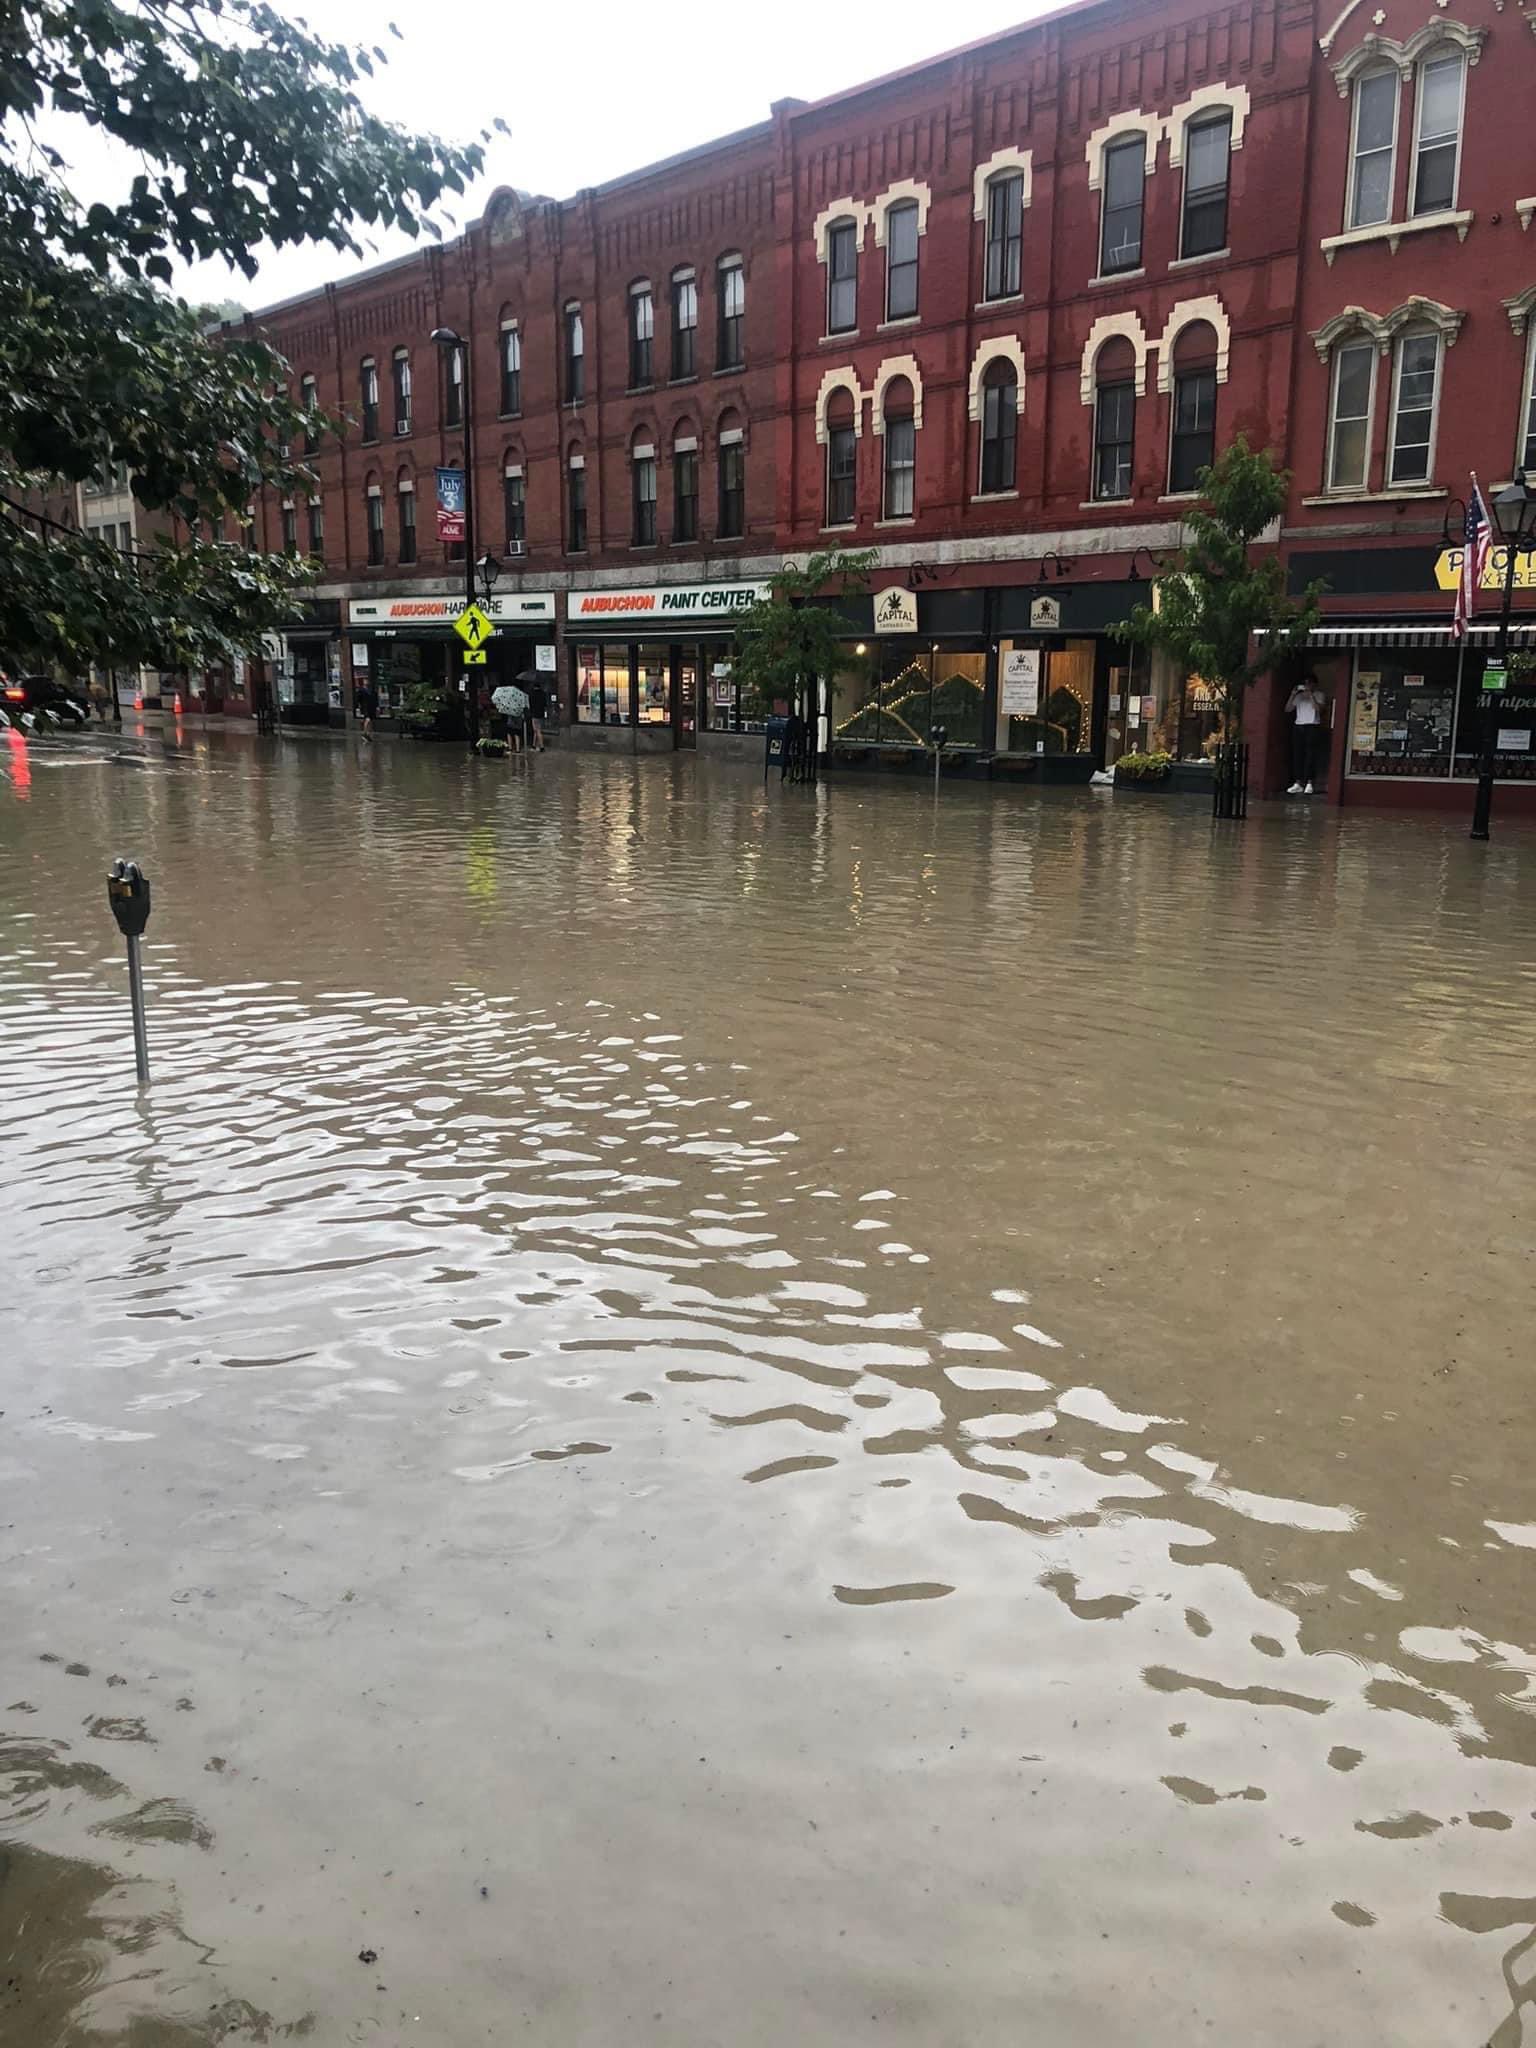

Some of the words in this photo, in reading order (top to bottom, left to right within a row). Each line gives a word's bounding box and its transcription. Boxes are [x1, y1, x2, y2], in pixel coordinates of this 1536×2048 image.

[439, 478, 461, 493] July
[1448, 549, 1509, 572] PO
[1483, 571, 1536, 586] XPRE
[390, 600, 445, 617] AUBUCHON
[444, 600, 503, 615] HARARE
[581, 595, 655, 613] AUBUCHON
[661, 592, 700, 610] PAINT
[701, 589, 755, 608] CENTER
[877, 609, 915, 623] CAPITAL
[1032, 612, 1058, 622] CAPITAL
[1008, 663, 1034, 673] CAPITAL
